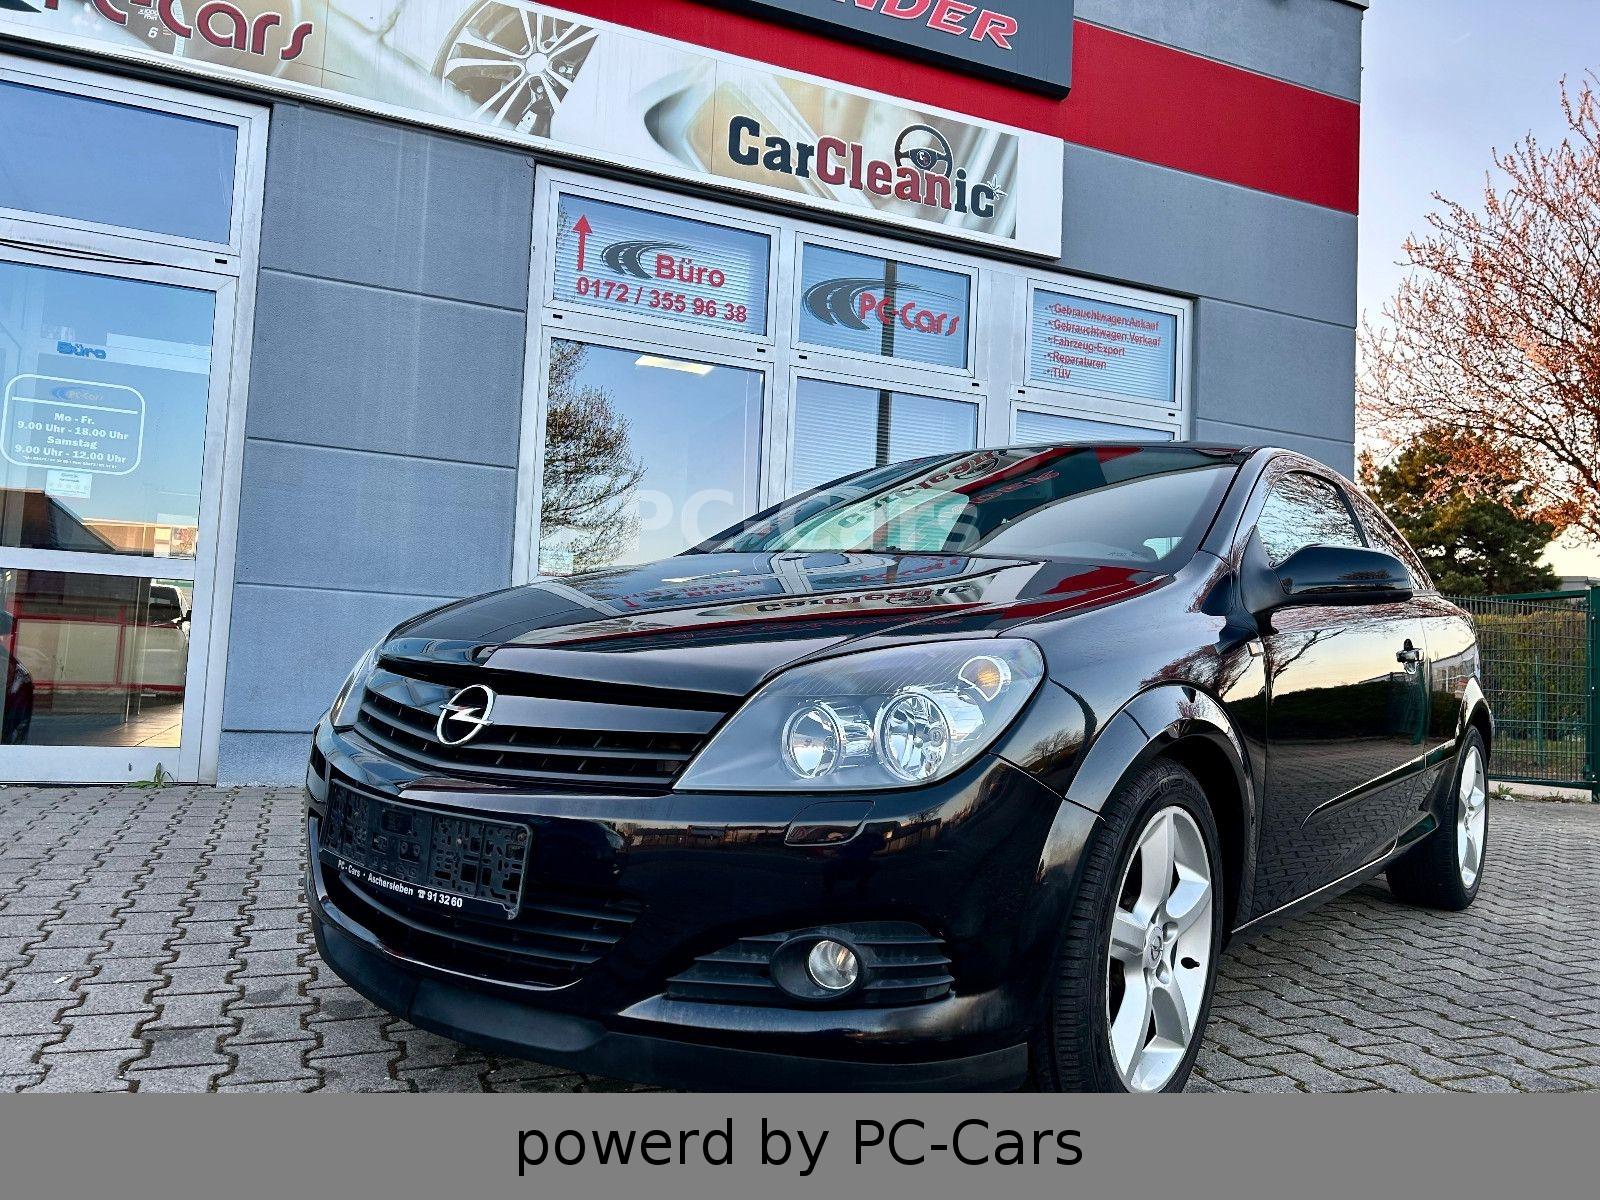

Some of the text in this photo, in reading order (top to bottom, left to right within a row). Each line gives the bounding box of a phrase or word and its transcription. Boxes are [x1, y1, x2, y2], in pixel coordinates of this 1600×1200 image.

[727, 115, 995, 217] CarCleanic
[655, 253, 725, 288] Büro
[577, 277, 629, 303] 0172
[649, 289, 686, 313] 355
[693, 297, 717, 318] 96
[723, 303, 747, 323] 38
[859, 292, 961, 337] PC-Cars
[57, 340, 107, 359] Büro
[54, 412, 72, 422] Mo
[80, 415, 95, 425] Fr.
[17, 420, 43, 431] 9.00
[45, 423, 66, 435] Uhr
[74, 426, 107, 438] 18.00
[108, 430, 129, 440] Uhr
[47, 435, 98, 450] Samstag
[14, 444, 41, 455] 9.00
[43, 447, 63, 457] Uhr
[72, 450, 104, 461] 12.00
[106, 453, 127, 464] Uhr
[367, 872, 414, 896] Aschersleben
